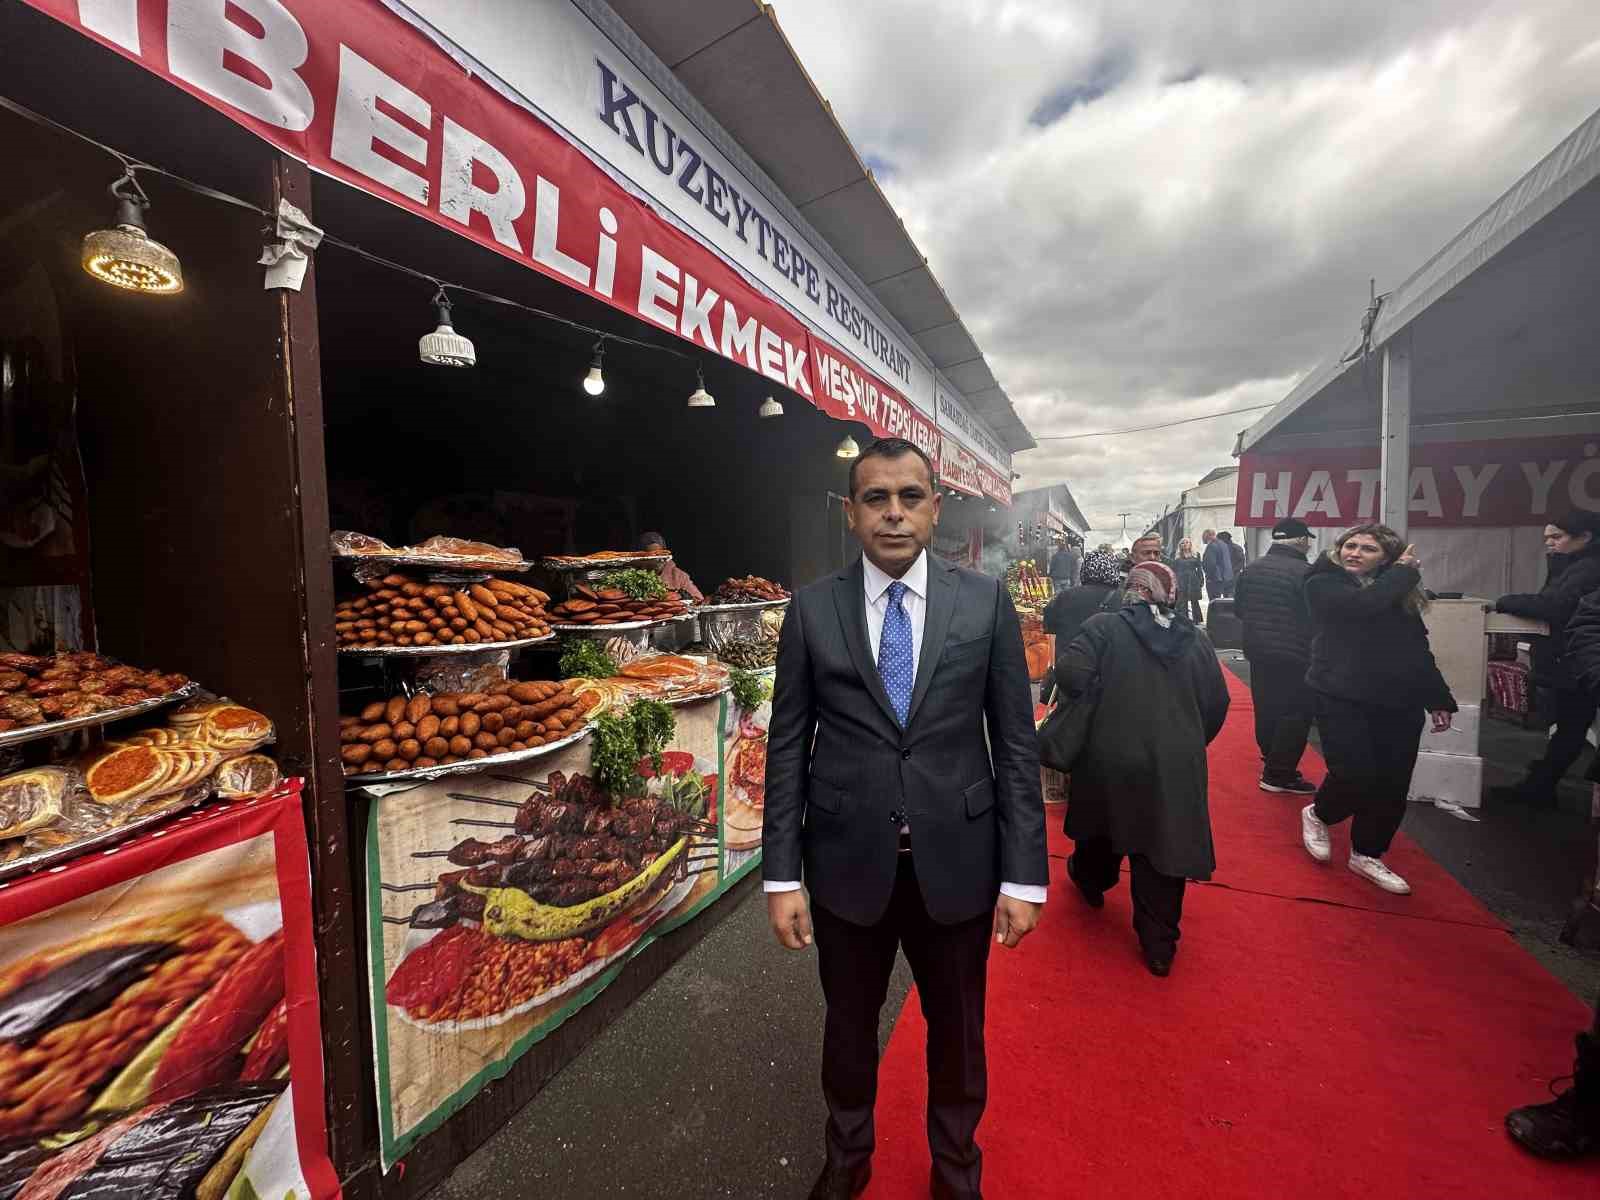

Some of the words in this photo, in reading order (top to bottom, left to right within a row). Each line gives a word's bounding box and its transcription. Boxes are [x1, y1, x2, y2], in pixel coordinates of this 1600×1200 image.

[596, 58, 820, 306] KUZEYTEPE
[824, 287, 911, 385] RESTURANT
[637, 244, 813, 396] EKMEK
[1250, 465, 1500, 518] HATAY
